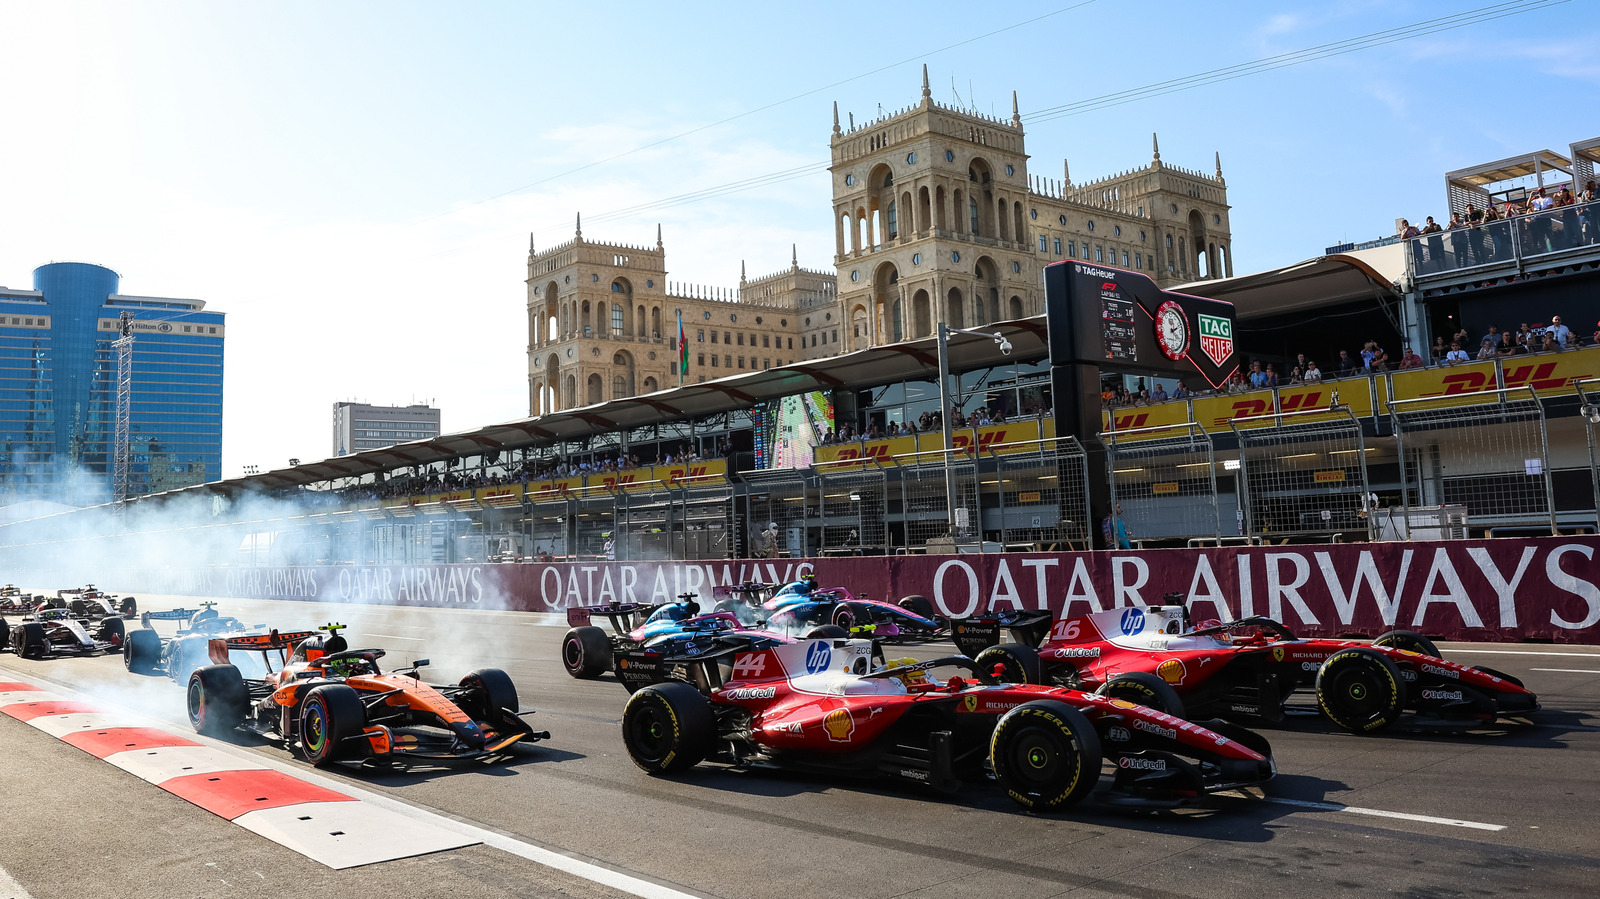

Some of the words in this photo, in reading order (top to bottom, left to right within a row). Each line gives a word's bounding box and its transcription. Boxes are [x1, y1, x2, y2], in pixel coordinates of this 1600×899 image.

[135, 322, 157, 330] Hilton
[1201, 317, 1230, 337] TAG
[1202, 337, 1232, 363] HEUER
[1442, 362, 1568, 396] DHL
[1232, 391, 1331, 424] DHL
[952, 430, 1013, 455] DHL
[837, 444, 895, 466] DHL
[603, 474, 637, 490] DHL
[670, 466, 709, 484] DHL
[540, 481, 569, 495] DHL
[226, 568, 262, 595] QATAR
[265, 568, 317, 598] AIRWAYS
[338, 567, 394, 600] QATAR
[398, 566, 483, 604] AIRWAYS
[540, 564, 638, 611] QATAR
[933, 555, 1150, 619] QATAR
[1186, 543, 1600, 630] AIRWAYS
[965, 626, 993, 634] V-Power
[1052, 619, 1081, 640] 16
[1122, 607, 1145, 636] hp
[808, 640, 831, 675] hp
[856, 646, 872, 655] ZCG
[1064, 647, 1100, 658] UniCredit
[628, 661, 657, 670] V-Power
[734, 653, 766, 677] 44
[1429, 665, 1460, 679] UniCredit
[623, 672, 652, 680] PERONI
[737, 686, 777, 699] UniCredit
[1116, 681, 1155, 697] ZERO
[1430, 690, 1463, 700] UniCredit
[1021, 708, 1031, 717] P
[1032, 709, 1073, 736] ZERO
[1141, 721, 1177, 740] UniCredit
[1110, 728, 1129, 740] FIA
[1128, 758, 1166, 771] UniCredit
[900, 769, 926, 780] ambipar
